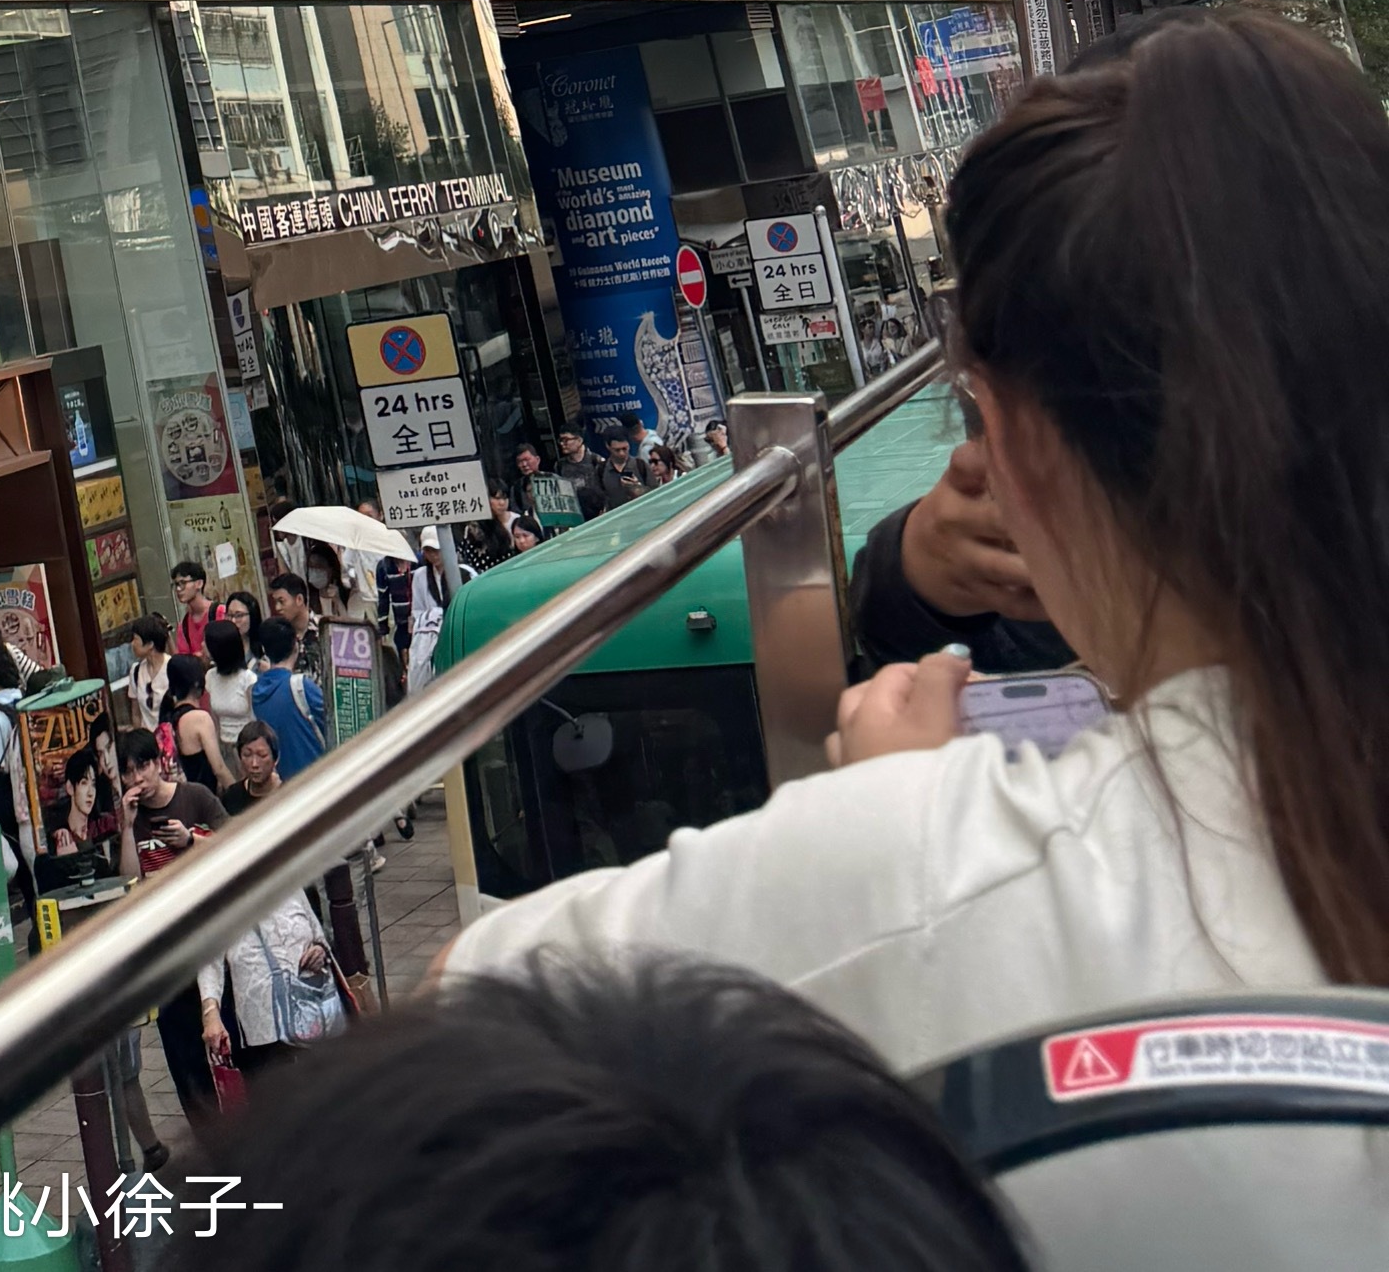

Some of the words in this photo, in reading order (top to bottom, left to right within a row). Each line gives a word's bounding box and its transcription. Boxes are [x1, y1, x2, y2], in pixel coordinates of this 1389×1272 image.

[545, 73, 617, 98] Coronet
[240, 195, 336, 243] 中國客運碼頭
[337, 189, 390, 228] CHINA
[388, 181, 440, 219] FERRY
[440, 173, 514, 210] TERMINAL
[557, 188, 615, 210] world's
[565, 199, 654, 232] diamond
[585, 227, 620, 249] art
[614, 258, 640, 271] World
[641, 254, 671, 268] Records
[715, 257, 751, 272] 小心車
[764, 265, 787, 279] 24
[790, 263, 817, 277] hrs
[773, 281, 816, 303] 全日
[374, 394, 409, 418] 24
[414, 392, 455, 413] hrs
[392, 420, 455, 455] 全日
[410, 471, 450, 485] Except
[398, 488, 419, 499] taxi
[422, 485, 448, 498] drop
[450, 482, 467, 493] off
[389, 497, 484, 520] 的士落客除外
[332, 627, 371, 658] 78
